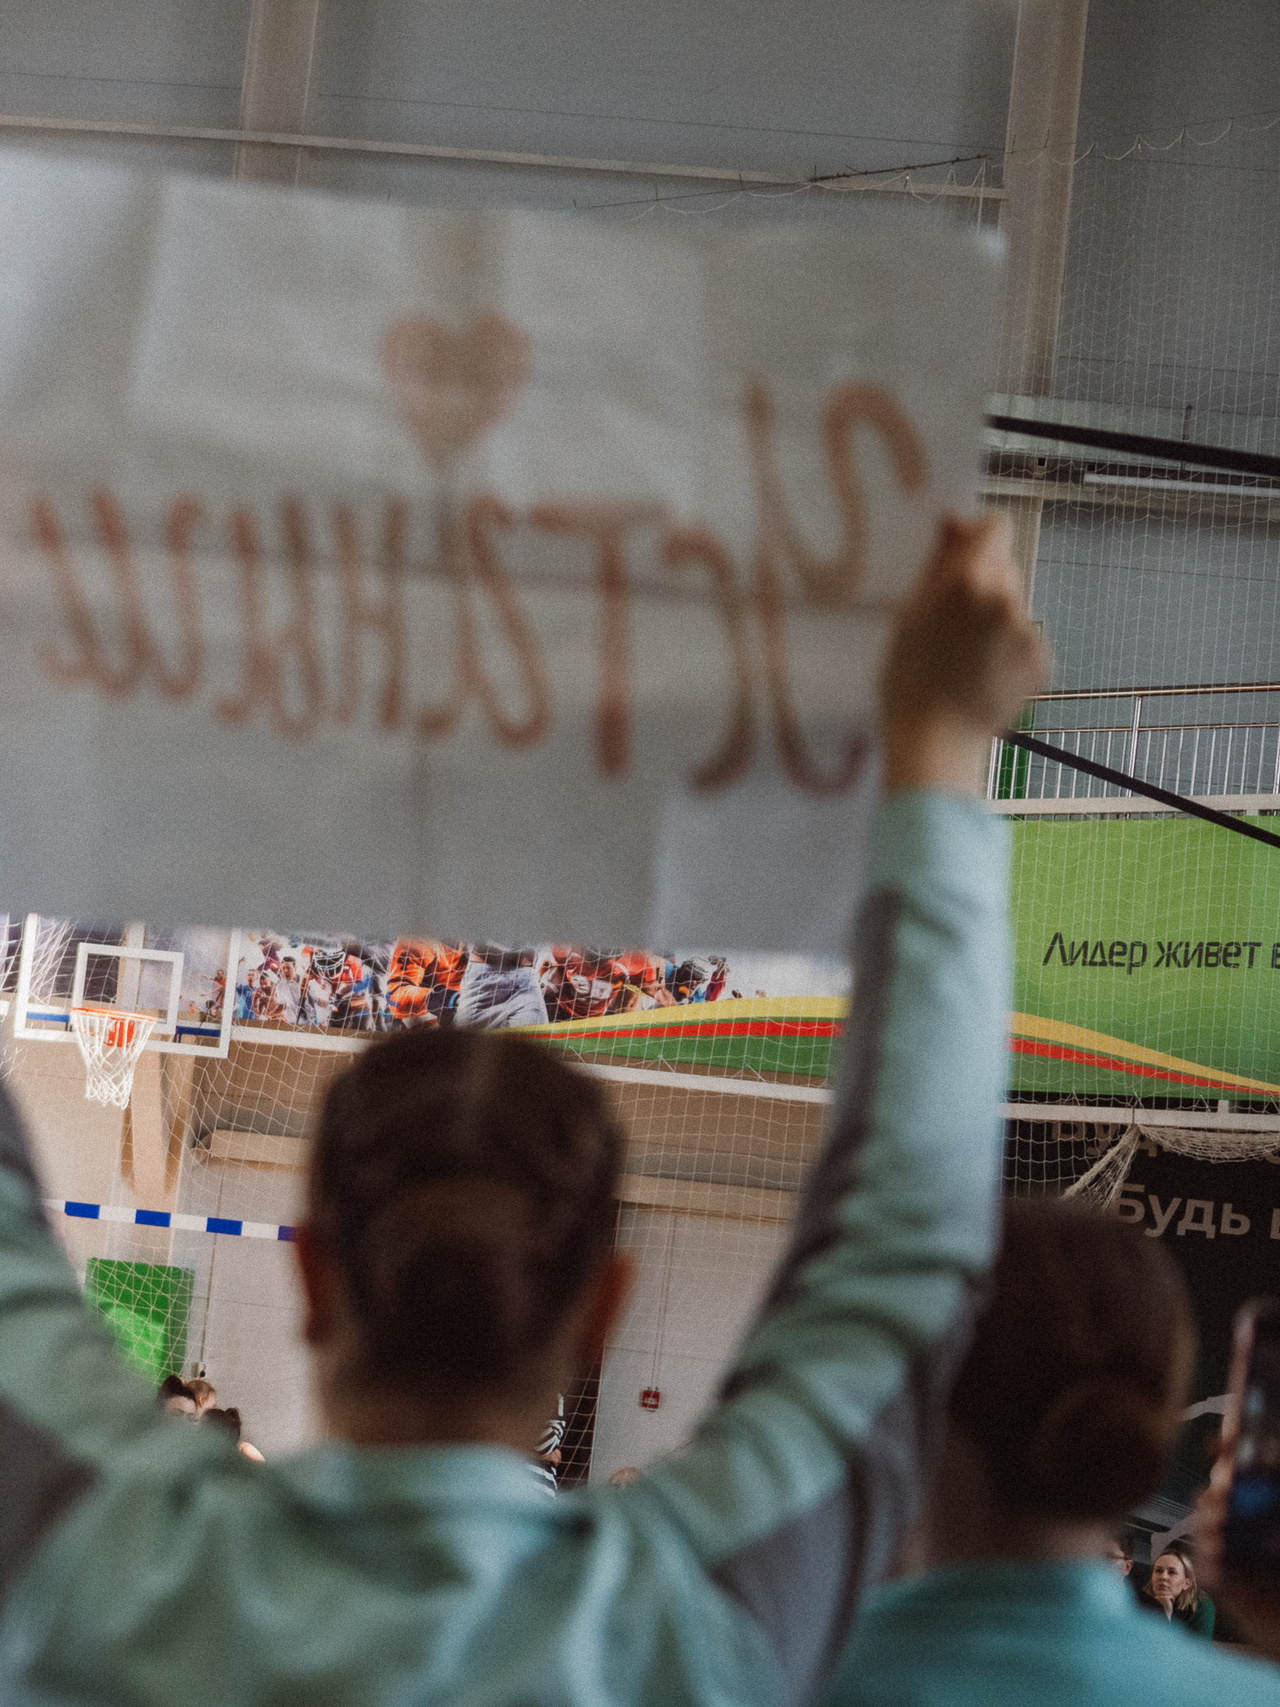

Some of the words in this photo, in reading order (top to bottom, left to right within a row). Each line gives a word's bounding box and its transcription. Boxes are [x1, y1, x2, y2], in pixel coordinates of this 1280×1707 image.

[1042, 931, 1148, 975] Лидер
[1154, 940, 1262, 970] живет
[1118, 1182, 1251, 1239] Будь
